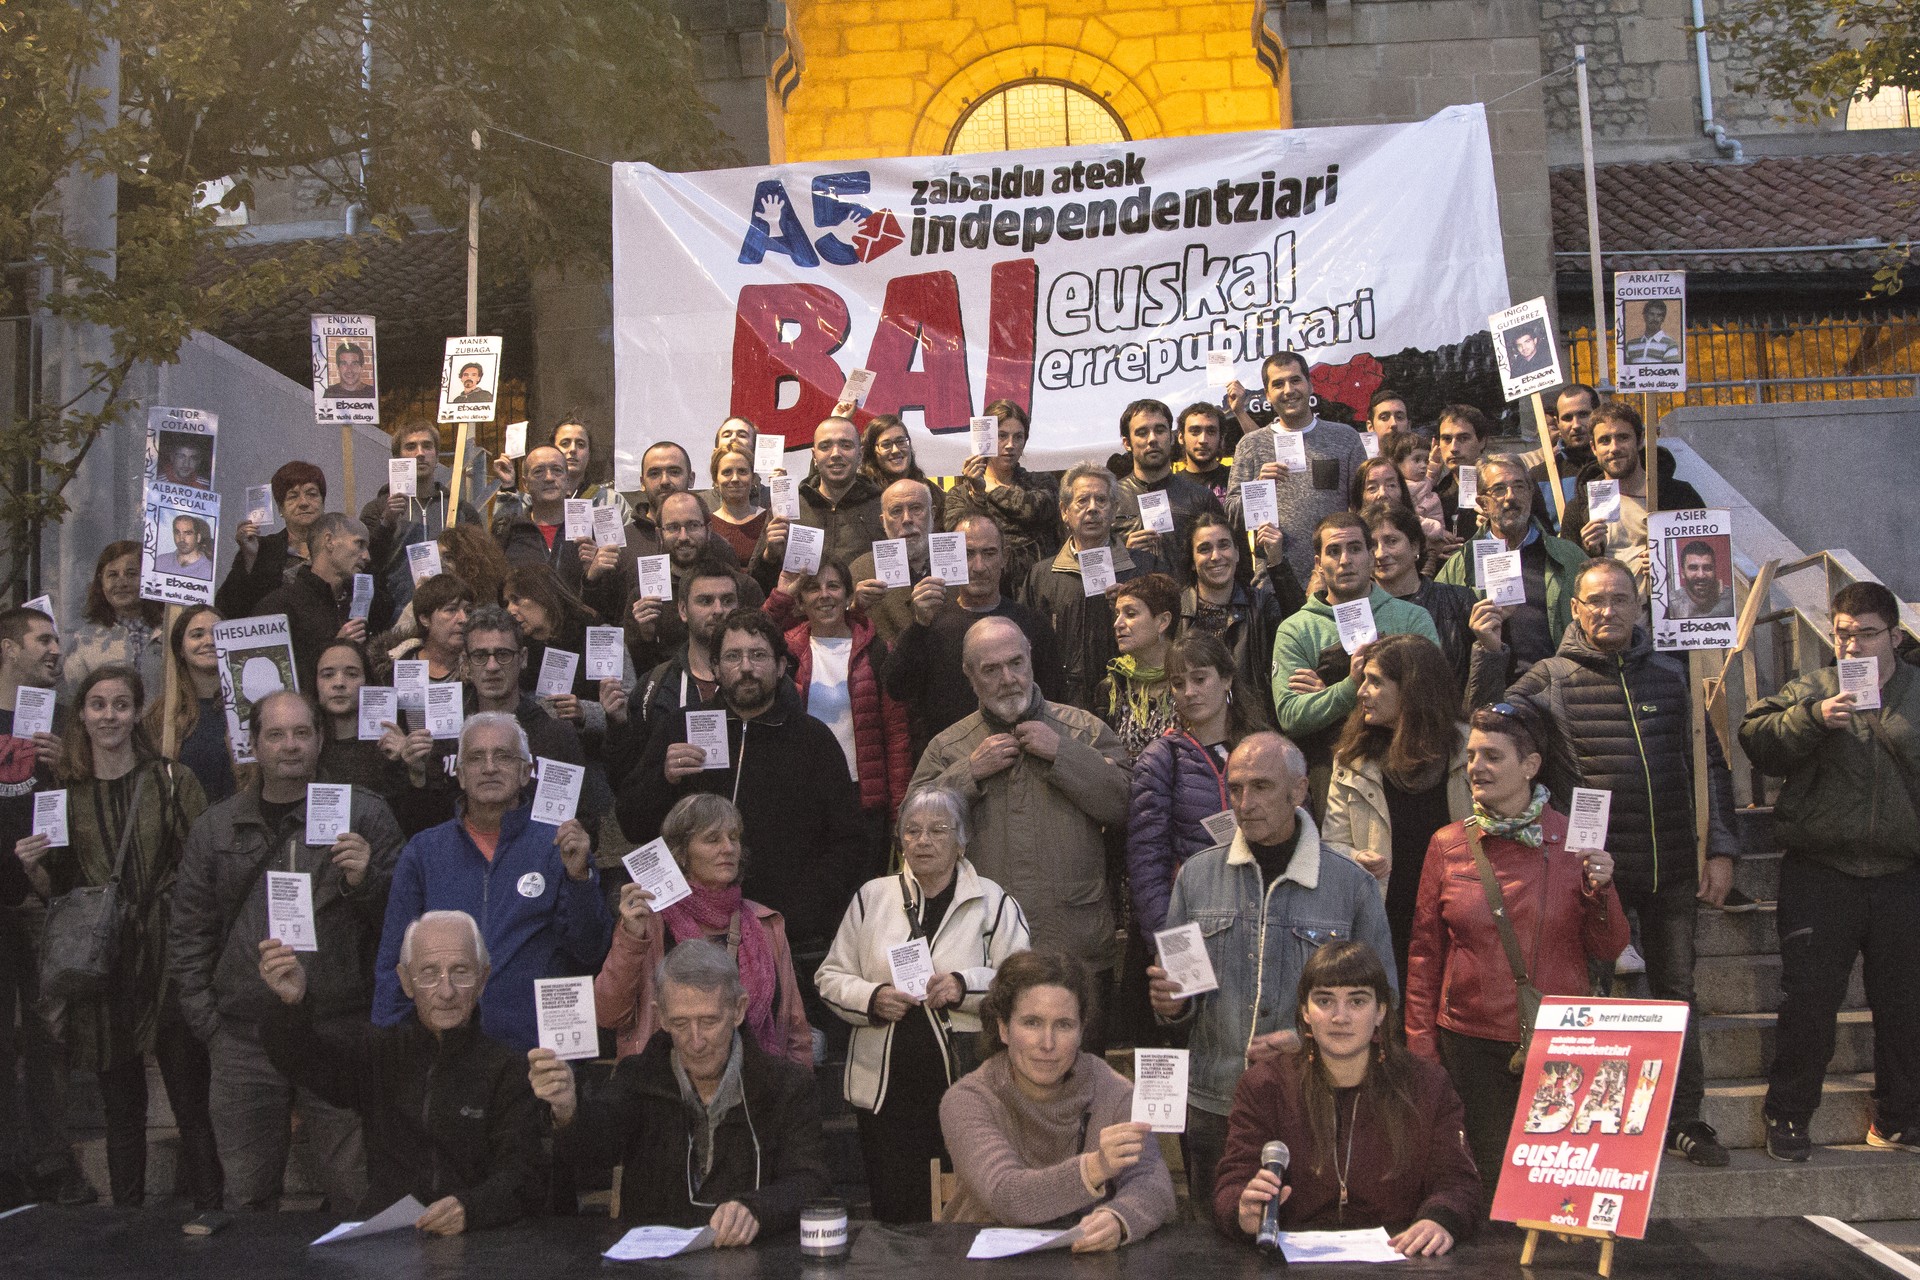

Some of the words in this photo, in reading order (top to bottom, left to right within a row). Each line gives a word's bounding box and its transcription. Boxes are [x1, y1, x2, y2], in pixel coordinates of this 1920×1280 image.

[911, 165, 1044, 207] zabaldu
[1052, 152, 1146, 195] ateak
[738, 170, 874, 268] A5
[909, 164, 1339, 256] independentziari
[1047, 230, 1298, 337] euskal
[1628, 274, 1669, 283] ARKAITZ
[1618, 287, 1681, 296] GOIKOETXEA
[328, 315, 362, 324] ENDIKA
[1497, 310, 1540, 330] GUTIERREZ
[1504, 304, 1528, 318] IÑIGO
[323, 327, 368, 335] LEJARZEGI
[1039, 287, 1375, 391] errepublikari
[731, 257, 1040, 449] BAI
[168, 409, 200, 419] AITOR
[161, 420, 205, 432] COTANO
[152, 483, 193, 498] ALBARO
[194, 491, 218, 502] ARRI
[160, 494, 206, 510] PASCUAL
[1675, 510, 1707, 521] ASIER
[1664, 524, 1719, 536] BORRERO
[215, 621, 288, 641] IHESLARIAK
[1681, 638, 1701, 646] nahi
[1702, 637, 1730, 647] ditugu
[1560, 1006, 1592, 1027] A5
[1599, 1013, 1621, 1023] herri
[1622, 1014, 1663, 1023] kontsulta
[1524, 1059, 1663, 1135] BAI
[1512, 1141, 1600, 1170] euskal
[1528, 1166, 1649, 1191] errepublikari
[1550, 1214, 1579, 1226] sortu
